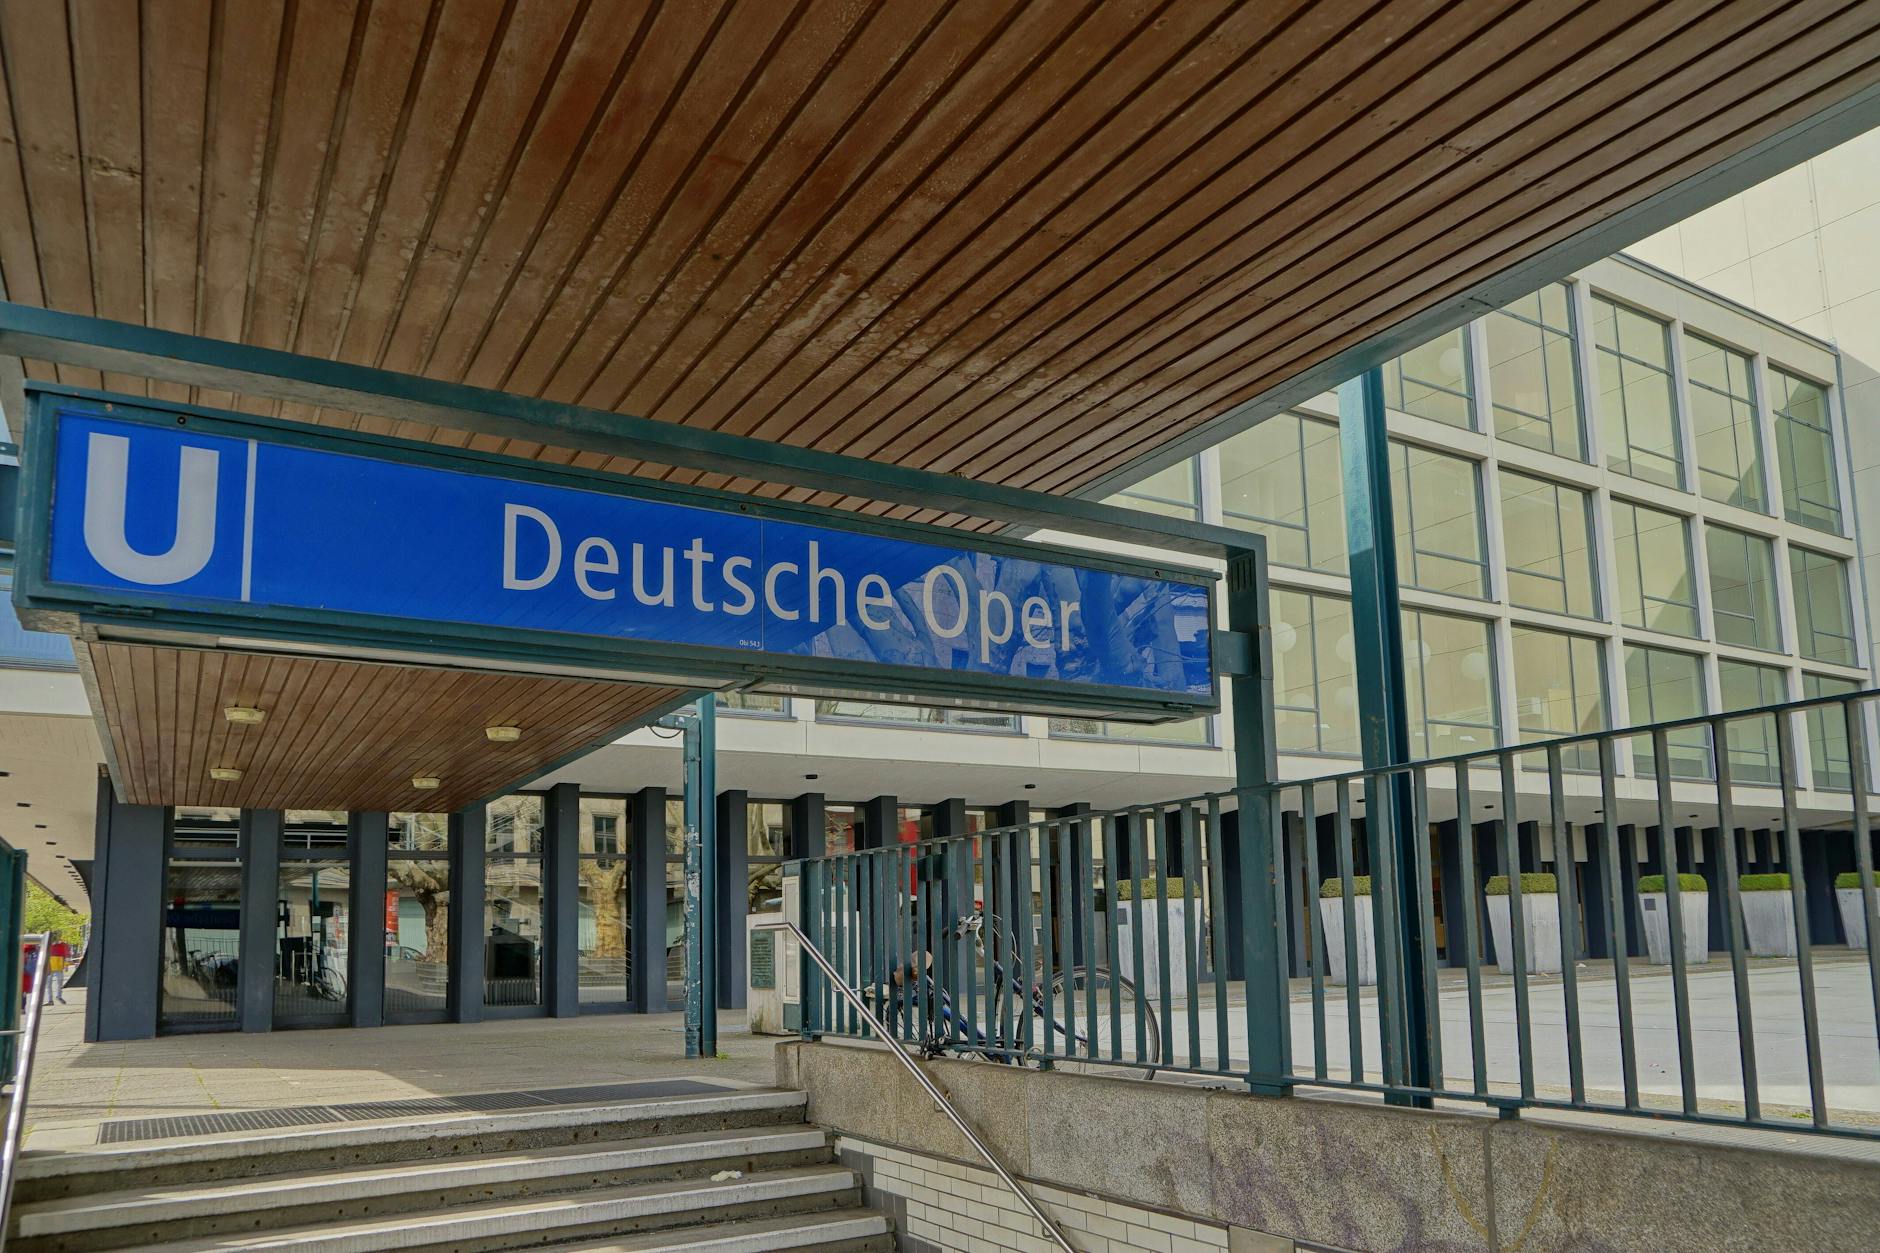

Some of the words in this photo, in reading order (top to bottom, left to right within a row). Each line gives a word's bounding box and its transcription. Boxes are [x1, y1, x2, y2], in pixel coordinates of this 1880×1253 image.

[83, 432, 220, 586] U
[503, 502, 895, 631] Deutsche
[923, 564, 1082, 664] Oper
